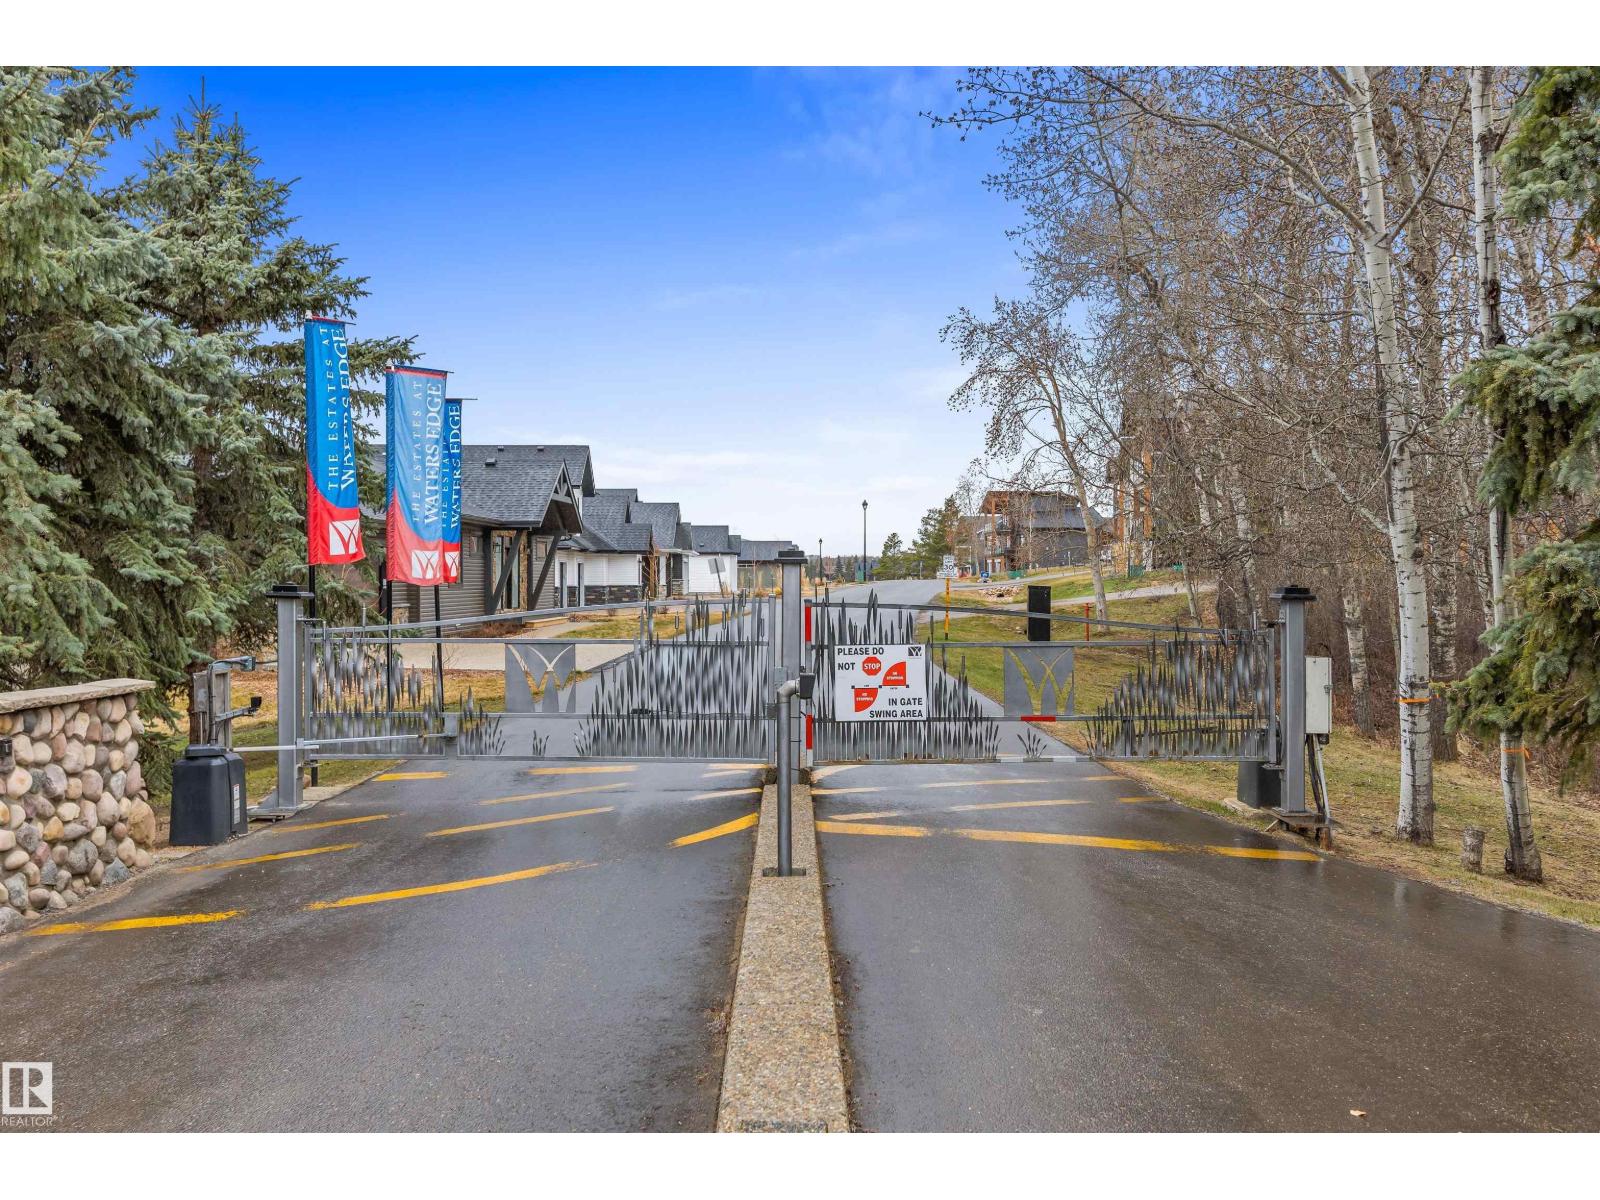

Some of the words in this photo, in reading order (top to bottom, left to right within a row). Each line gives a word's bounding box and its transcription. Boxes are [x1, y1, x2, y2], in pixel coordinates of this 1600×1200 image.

[319, 326, 331, 345] AT
[325, 359, 338, 441] ESTATES
[413, 381, 423, 400] AT
[425, 383, 442, 439] EDGE
[448, 405, 461, 453] EDGE
[412, 410, 422, 481] ESTATES
[327, 454, 339, 490] THE
[424, 444, 440, 525] WATERS
[412, 491, 420, 523] THE
[837, 647, 870, 656] PLEASE
[872, 646, 884, 655] DO
[837, 662, 855, 671] NOT
[863, 662, 881, 670] STOP
[869, 709, 898, 718] SWING
[900, 709, 923, 718] AREA
[888, 698, 898, 706] IN
[900, 697, 923, 706] GATE
